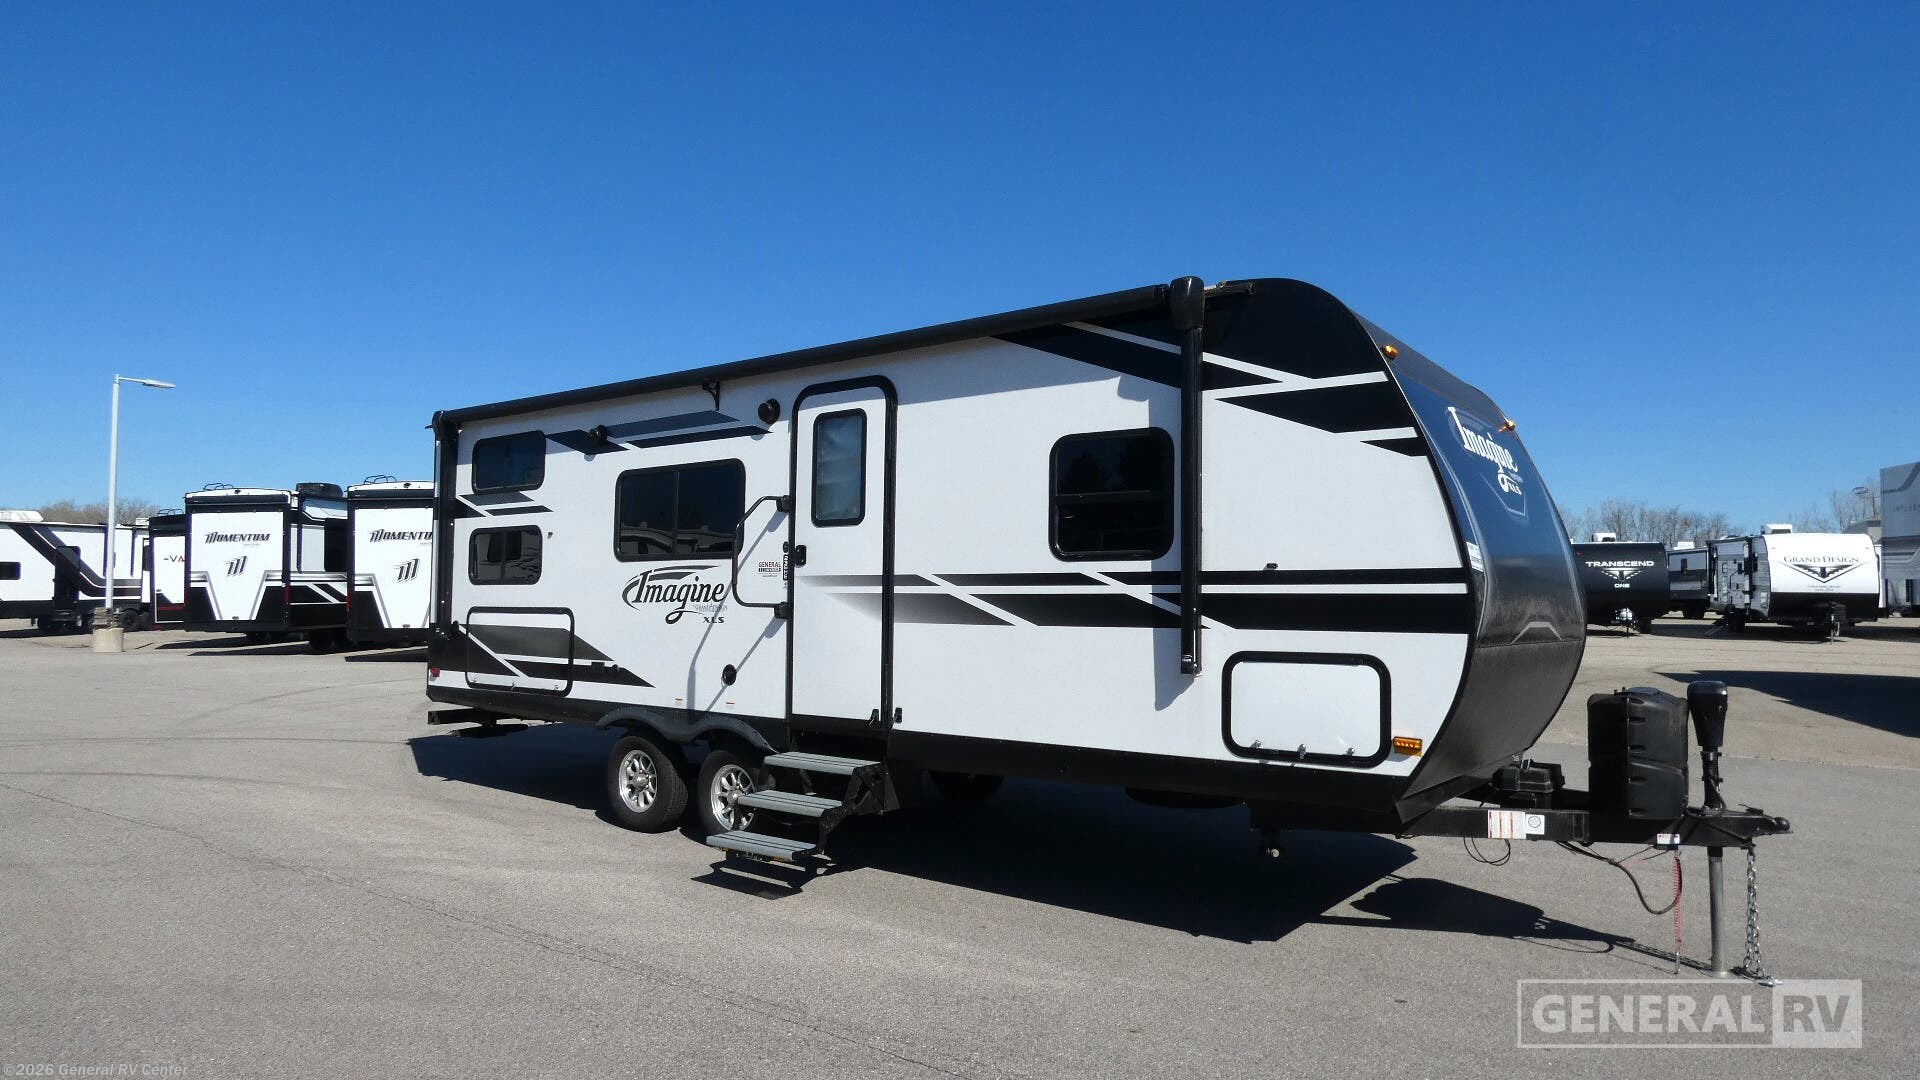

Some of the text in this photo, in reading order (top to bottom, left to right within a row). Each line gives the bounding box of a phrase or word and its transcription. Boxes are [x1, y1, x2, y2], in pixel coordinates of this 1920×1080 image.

[1447, 407, 1518, 493] Imagine
[205, 532, 271, 544] MOMENTUM
[369, 529, 432, 542] MOMENTU
[631, 569, 728, 625] Imagine
[702, 616, 725, 624] XLS
